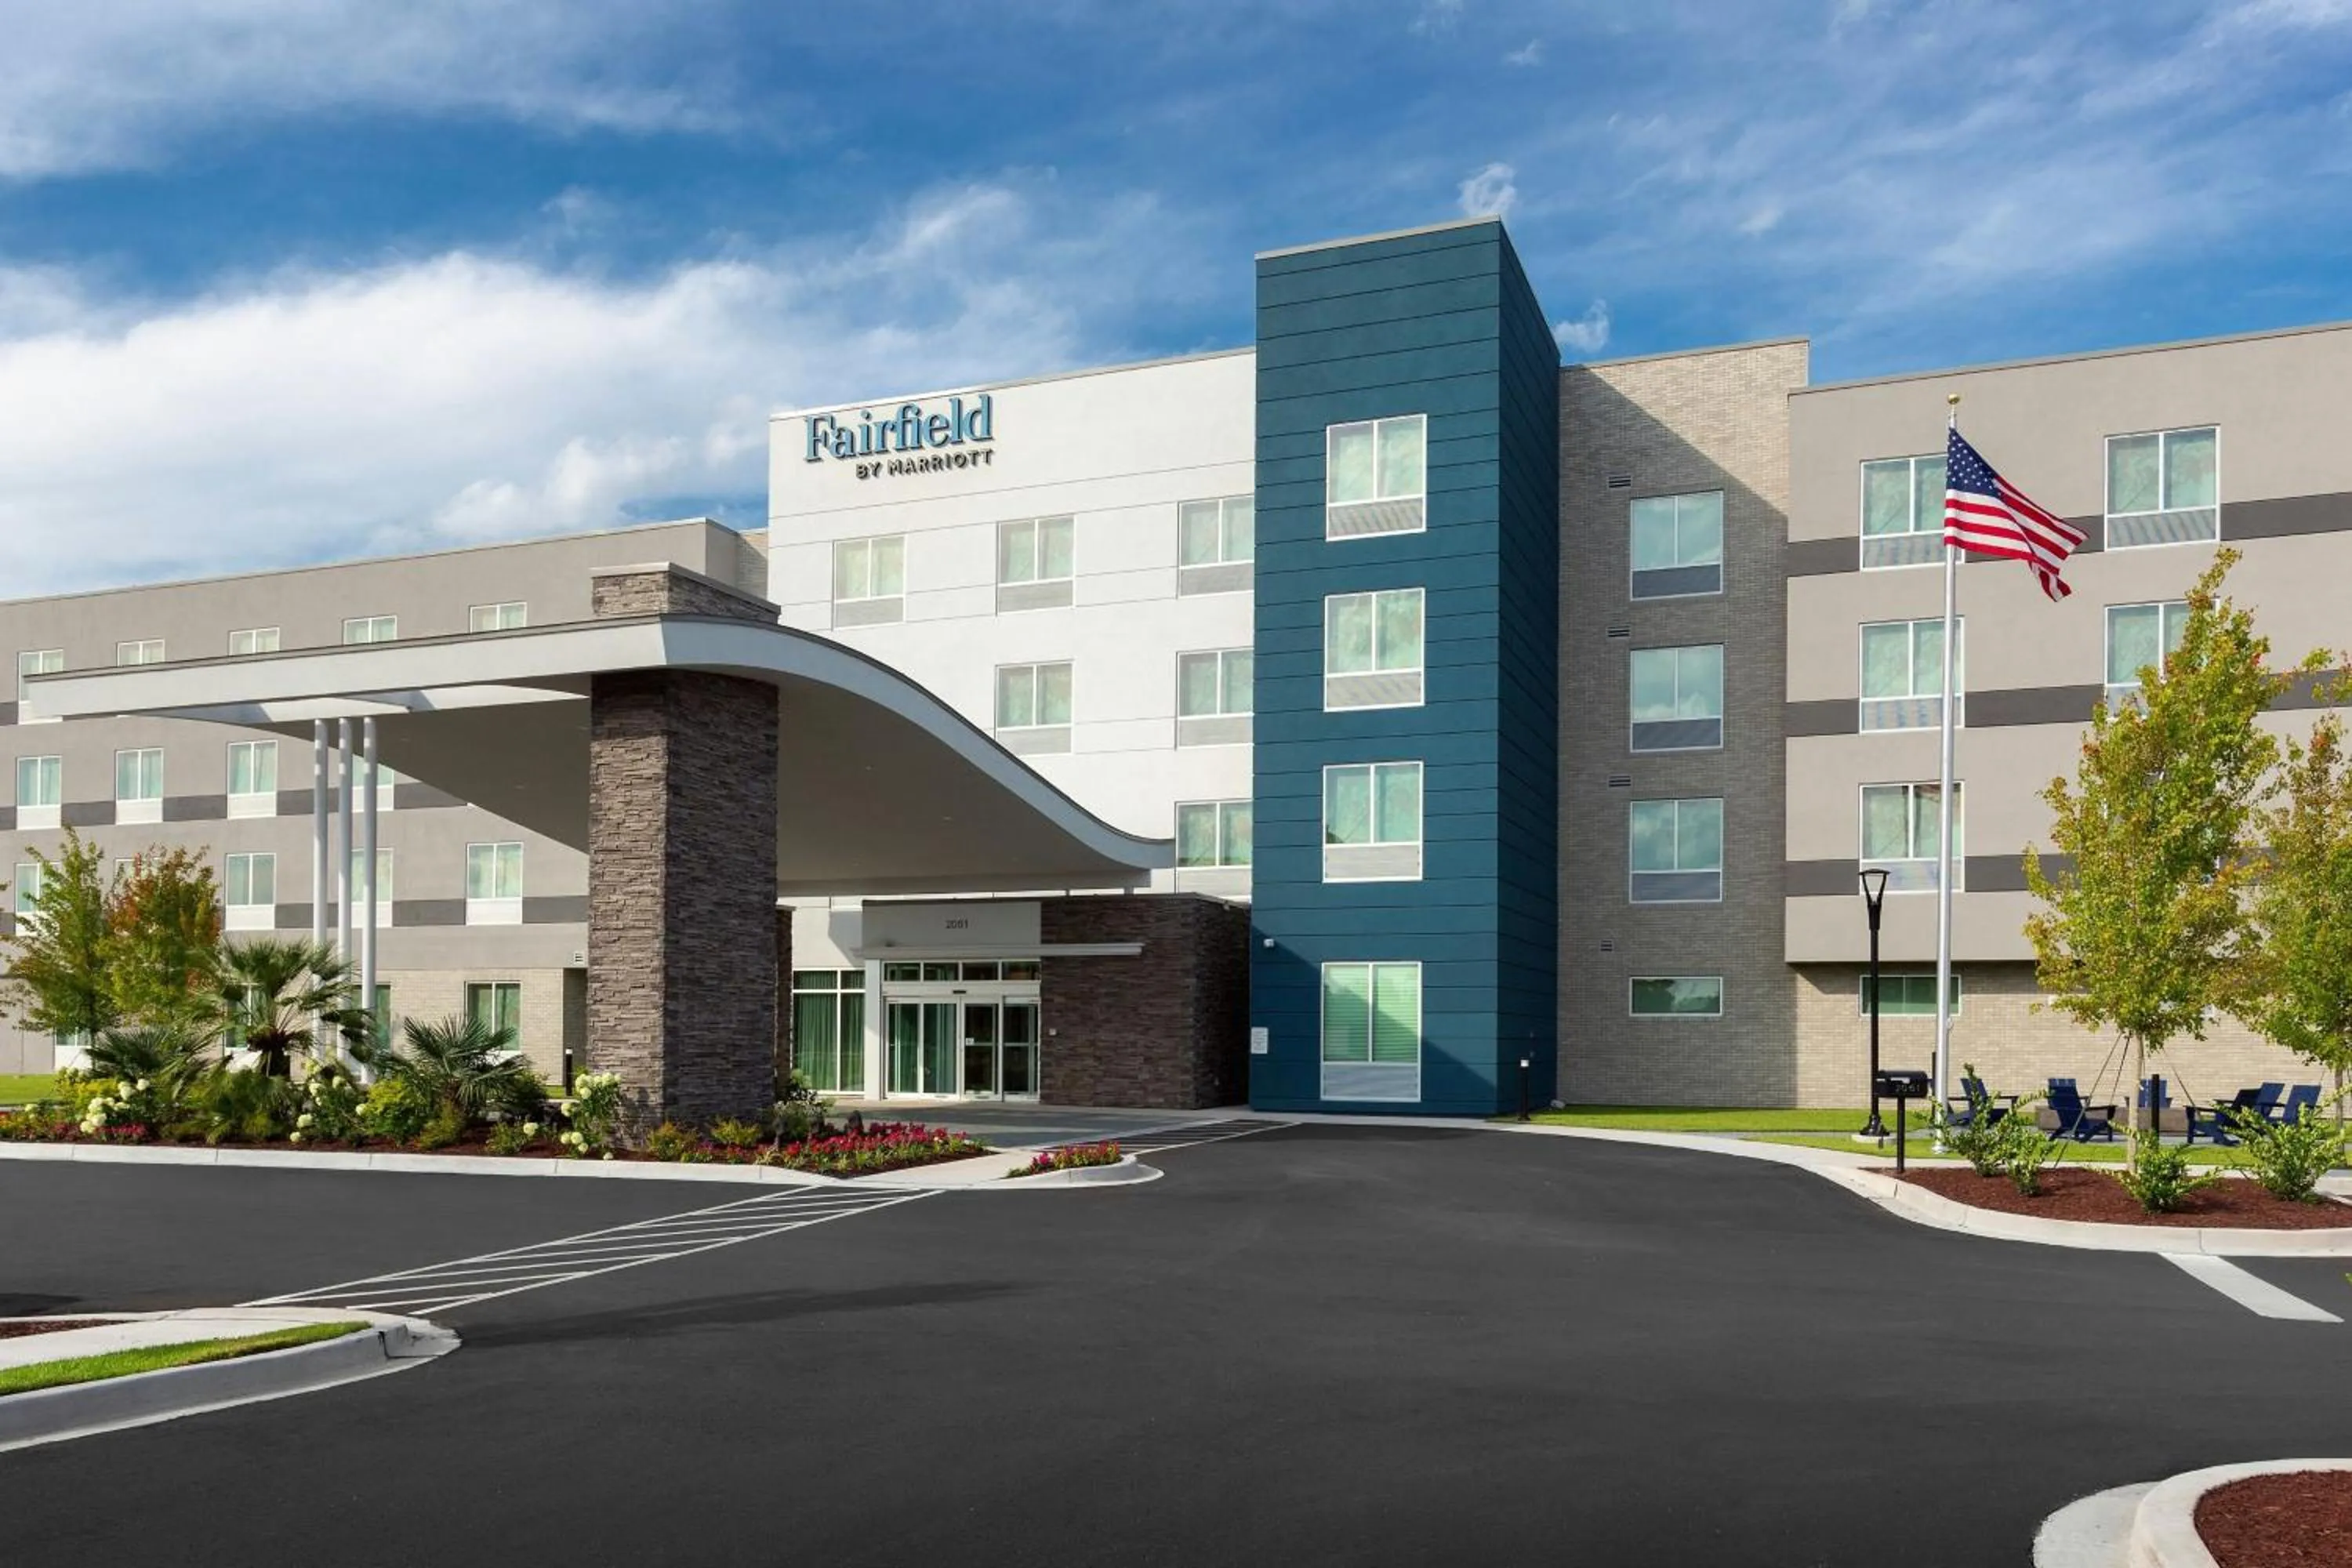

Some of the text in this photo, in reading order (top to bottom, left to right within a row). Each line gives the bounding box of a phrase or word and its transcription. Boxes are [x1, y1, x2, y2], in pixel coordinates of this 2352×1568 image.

[804, 394, 993, 462] Fairfield
[855, 448, 994, 480] BY MARRIOTT
